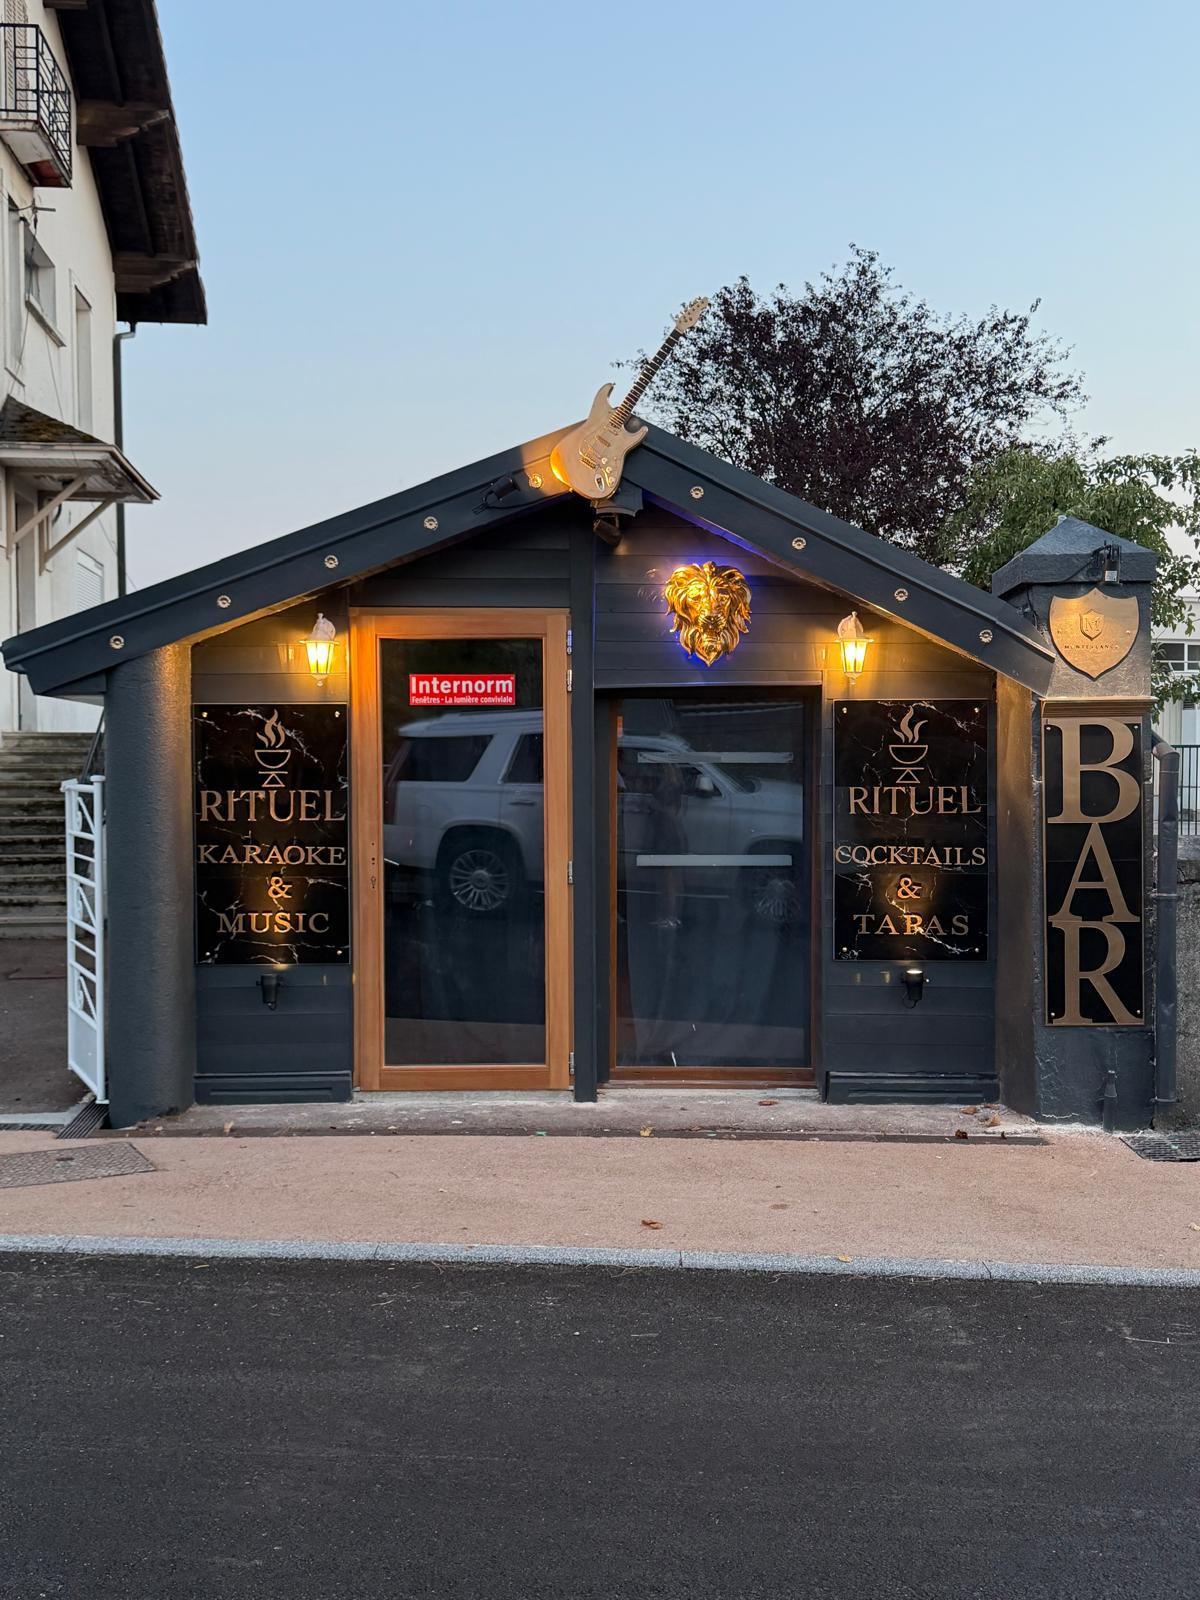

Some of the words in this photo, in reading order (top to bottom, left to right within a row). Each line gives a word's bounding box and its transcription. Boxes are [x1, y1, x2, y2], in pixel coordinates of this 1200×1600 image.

[411, 676, 513, 694] Internorm
[412, 696, 440, 704] Fenêtres
[454, 695, 479, 703] lumière
[480, 695, 513, 703] conviviale
[200, 790, 346, 822] RITUEL
[849, 786, 982, 815] RITUEL
[198, 845, 347, 866] KARAOKE
[835, 845, 986, 866] COCKTAILS
[1047, 717, 1143, 1025] BAR
[267, 876, 292, 899] &
[897, 877, 922, 900] &
[216, 912, 330, 934] MUSIC
[853, 914, 969, 936] TAPAS
